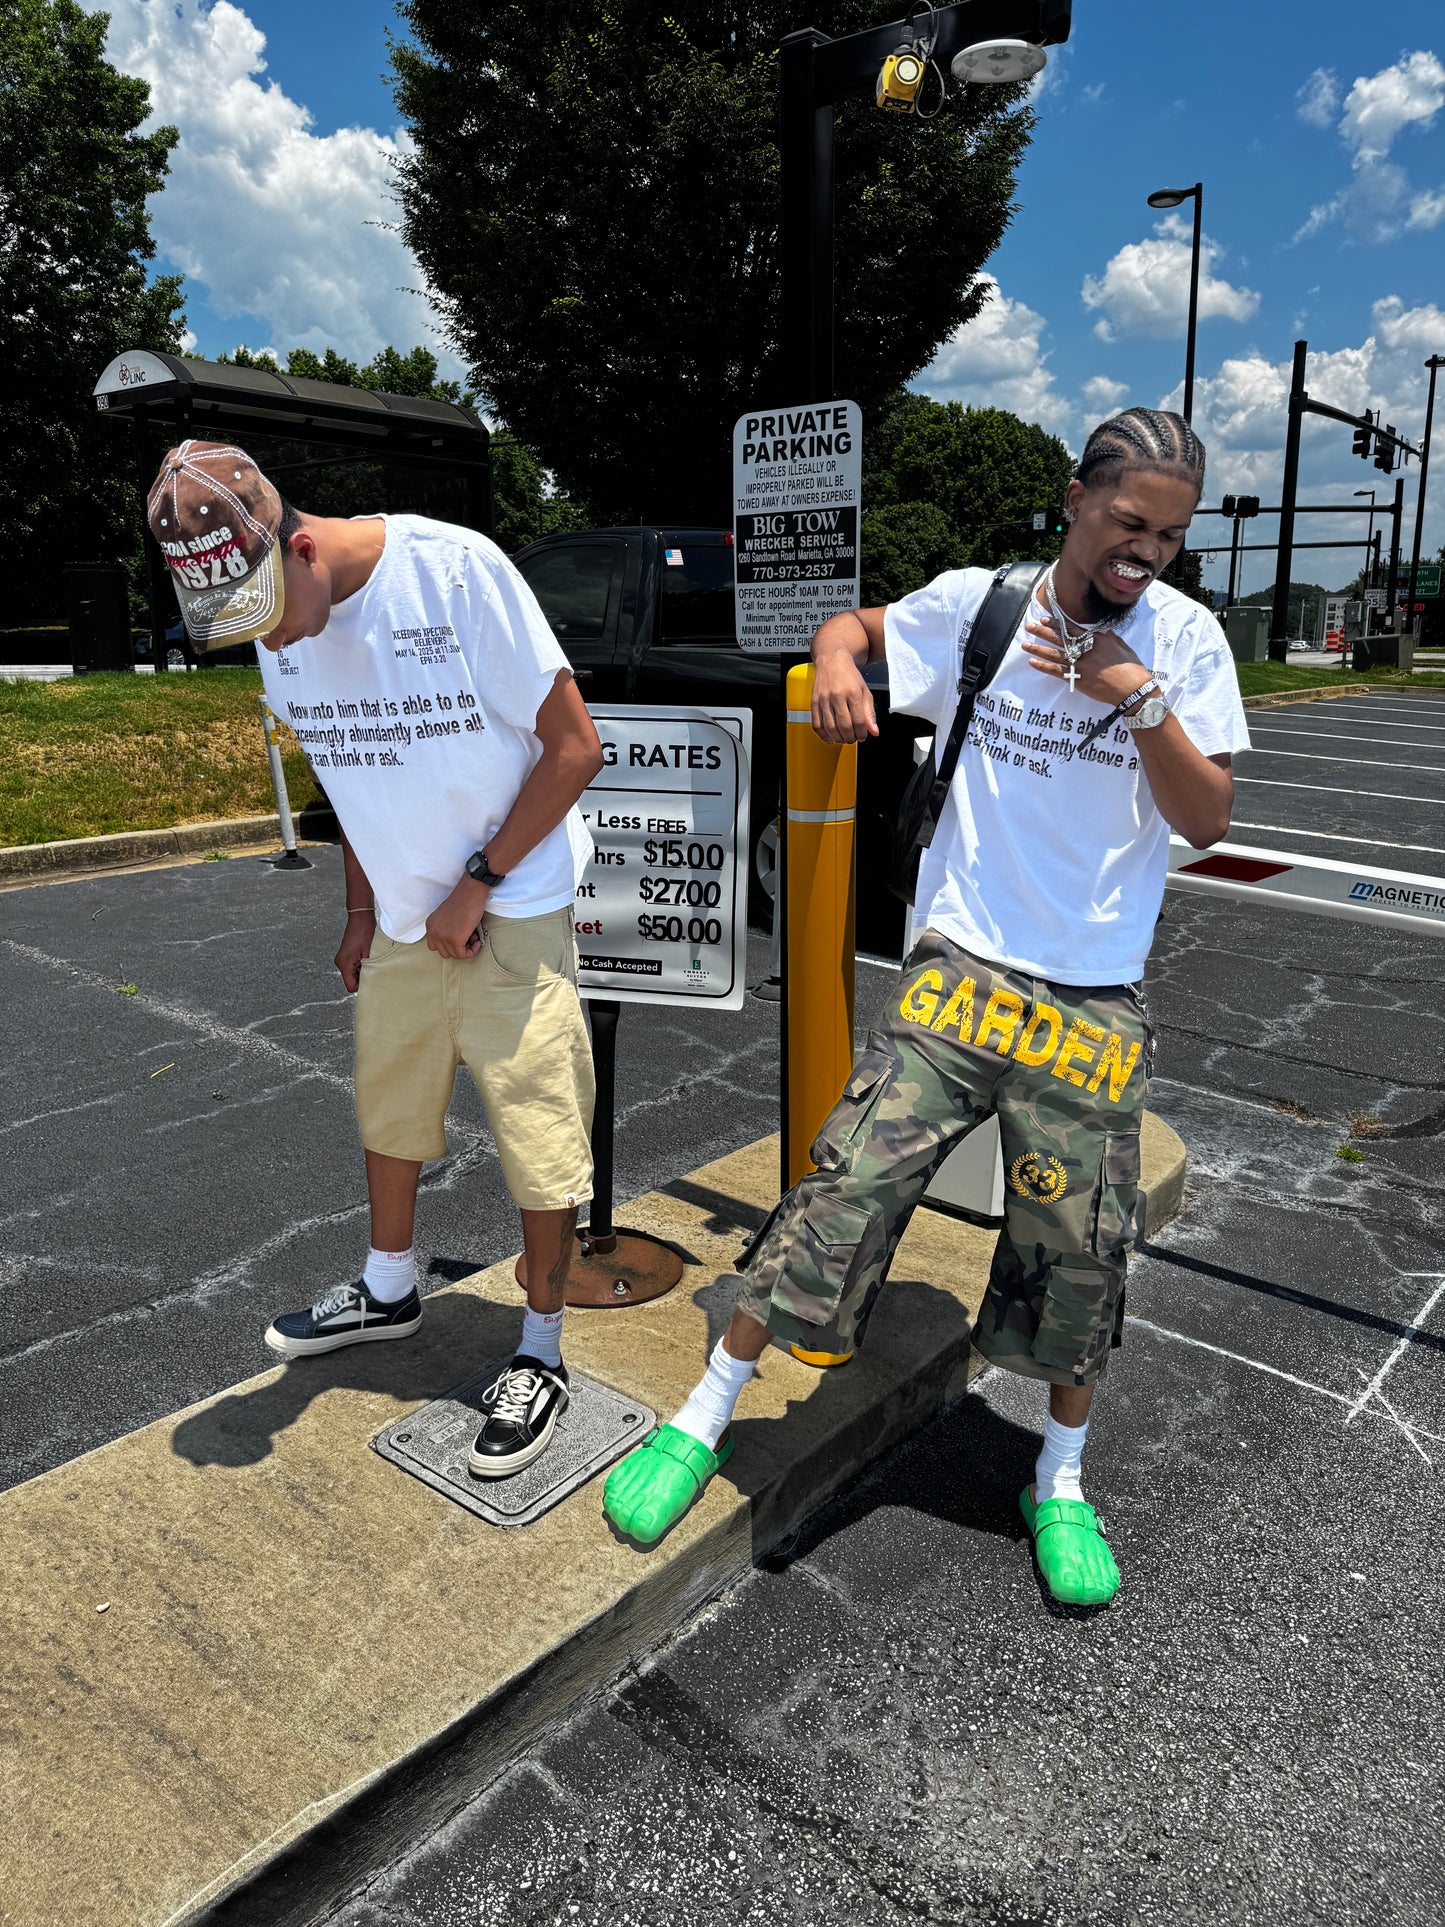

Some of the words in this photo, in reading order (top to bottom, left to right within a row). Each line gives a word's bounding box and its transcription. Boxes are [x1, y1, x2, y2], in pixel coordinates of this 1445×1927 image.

[130, 371, 146, 385] LINC
[746, 406, 848, 440] PRIVATE
[742, 431, 852, 465] PARKING
[755, 465, 786, 479] VEHICLES
[788, 462, 824, 476] ILLEGALLY
[826, 460, 837, 473] OR
[745, 480, 786, 495] IMPROPERLY
[788, 478, 815, 491] PARKED
[816, 476, 833, 489] WILL
[834, 475, 844, 487] BE
[737, 499, 760, 510] TOWED
[761, 496, 780, 508] AWAY
[781, 495, 790, 506] AT
[791, 492, 820, 505] OWNERS
[821, 489, 856, 503] EXPENSE!
[752, 515, 786, 536] BIG
[793, 510, 841, 533] TOW
[187, 526, 233, 553] since
[744, 536, 794, 551] WRECKER
[800, 533, 845, 548] SERVICE
[738, 552, 750, 563] 1260
[751, 551, 779, 563] Sandtown
[780, 549, 796, 561] Road
[798, 548, 824, 560] Marietta,
[824, 547, 835, 559] GA
[172, 545, 249, 589] 1928
[752, 563, 836, 580] 770-973-2537
[738, 588, 766, 599] OFFICE
[768, 586, 796, 598] HOURS
[799, 586, 819, 597] 10AM
[822, 585, 834, 596] TO
[836, 584, 855, 596] 6PM
[741, 600, 754, 611] Call
[757, 600, 766, 610] for
[768, 599, 813, 612] appointment
[816, 598, 853, 608] weekends
[745, 613, 775, 623] Minimum
[778, 612, 803, 624] Towing
[805, 611, 818, 621] Fee
[392, 628, 422, 640] XCEEDING
[742, 625, 772, 635] MINIMUM
[774, 624, 809, 635] STORAGE
[413, 636, 448, 647] BELIEVERS
[740, 638, 756, 648] CASH
[758, 638, 762, 647] &
[764, 637, 796, 647] CERTIFIED
[395, 649, 407, 658] MAY
[417, 646, 434, 656] 2025
[419, 655, 433, 665] EPH
[433, 654, 447, 664] 3:20
[278, 658, 290, 667] DATE
[280, 667, 299, 675] SUBJECT
[286, 701, 309, 720] Now
[335, 699, 359, 719] him
[360, 697, 383, 718] that
[382, 697, 399, 717] is
[402, 694, 432, 715] able
[436, 692, 453, 711] to
[456, 689, 476, 709] do
[998, 698, 1024, 722] him
[1026, 707, 1056, 729] that
[1058, 711, 1074, 733] is
[1114, 724, 1129, 744] to
[349, 721, 412, 746] abundantly
[415, 717, 461, 741] above
[629, 742, 722, 770] RATES
[1003, 725, 1077, 762] abundantly
[1078, 742, 1124, 768] above
[314, 752, 330, 768] can
[330, 747, 363, 768] think
[364, 751, 376, 767] or
[378, 747, 404, 767] ask.
[1012, 752, 1026, 768] or
[1028, 757, 1052, 779] ask.
[597, 809, 642, 830] Less
[594, 846, 626, 866] hrs
[643, 838, 725, 870] $15.00
[639, 875, 722, 908] $27.00
[1368, 898, 1396, 906] ACCESS
[637, 912, 722, 945] $50.00
[578, 957, 590, 967] No
[591, 958, 613, 968] Cash
[615, 960, 659, 973] Accepted
[899, 968, 1142, 1104] GARDEN
[1021, 1163, 1058, 1191] 33
